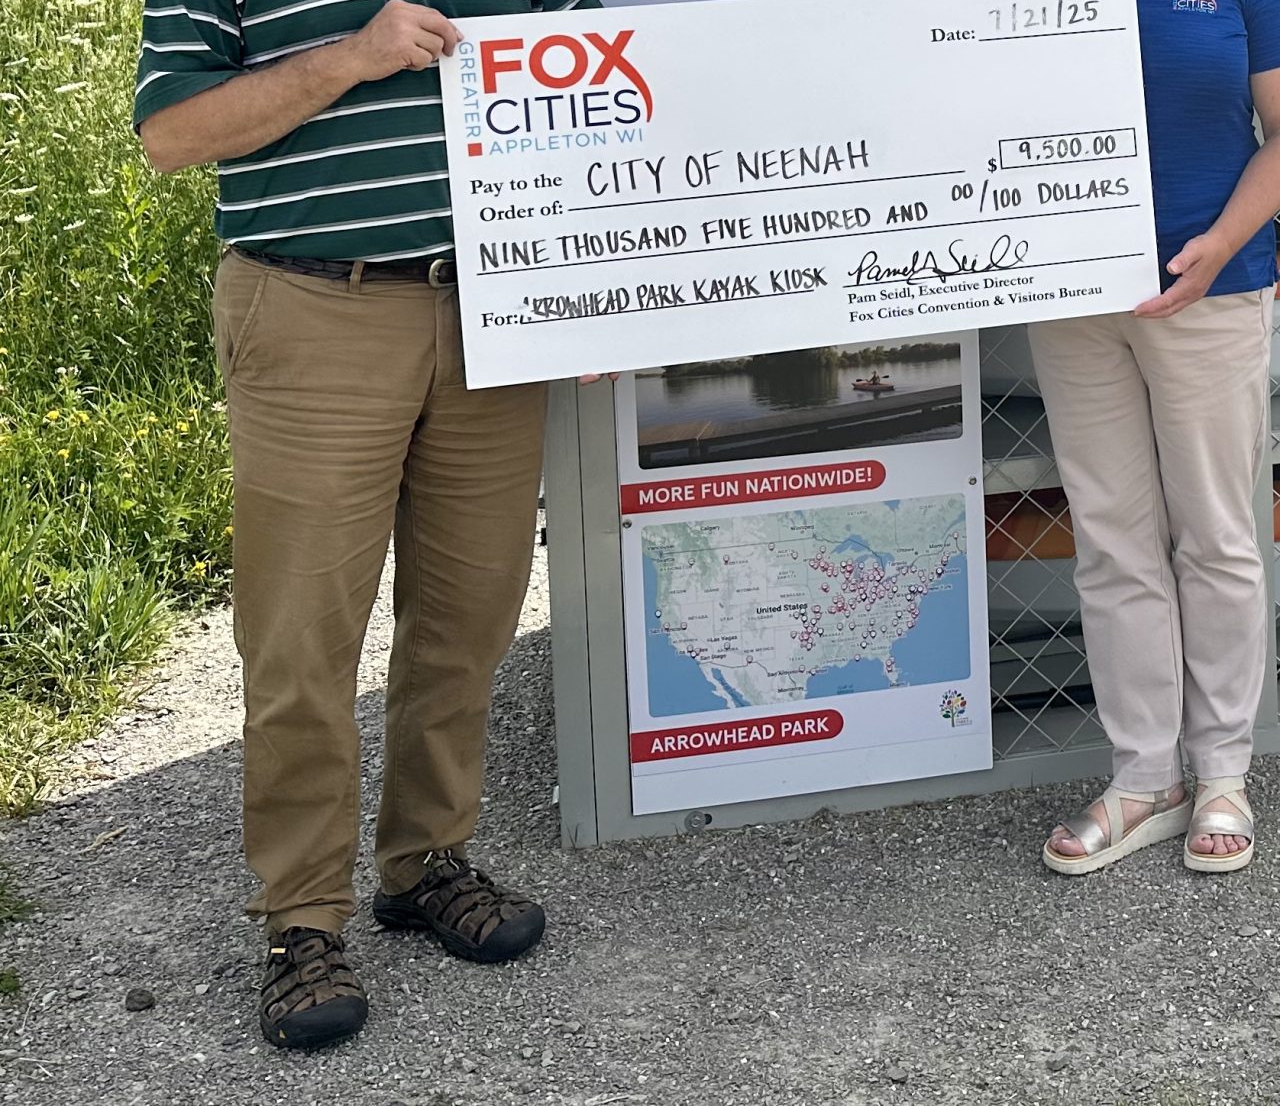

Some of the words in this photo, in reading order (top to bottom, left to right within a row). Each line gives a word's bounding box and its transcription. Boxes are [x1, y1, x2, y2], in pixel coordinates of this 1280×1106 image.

[1177, 0, 1215, 11] CITIES
[930, 28, 976, 42] Date:
[459, 41, 481, 138] GREATER
[480, 30, 653, 122] FOX
[486, 89, 641, 134] CITIES
[489, 131, 607, 155] APPLETON
[616, 128, 643, 143] WI
[1018, 134, 1116, 160] 9,500.00
[586, 156, 666, 197] CITY
[685, 150, 724, 188] OF
[737, 139, 870, 182] NEENAH
[987, 158, 998, 173] $
[470, 179, 504, 196] Pay
[510, 176, 528, 191] to
[534, 173, 563, 189] the
[479, 205, 535, 223] Order
[540, 201, 564, 217] of:
[479, 239, 550, 271] NINE
[557, 225, 687, 261] THOUSAND
[700, 215, 753, 245] FIVE
[762, 206, 871, 237] HUNDRED
[886, 202, 928, 225] AND
[1038, 177, 1130, 204] DOLLARS
[636, 282, 685, 310] PARK
[693, 275, 758, 303] KAYAK
[770, 266, 828, 294] KIOSK
[848, 292, 877, 304] Pam
[880, 288, 915, 300] Seidl,
[918, 280, 980, 296] Executive
[983, 274, 1034, 288] Director
[849, 309, 874, 322] Fox
[877, 305, 914, 318] Cities
[917, 297, 989, 314] Convention
[993, 295, 1005, 305] &
[1008, 290, 1055, 304] Visitors
[1058, 285, 1103, 299] Bureau
[481, 311, 519, 328] For:
[638, 485, 696, 505] MORE
[701, 480, 739, 499] FUN
[745, 467, 873, 495] NATIONWIDE!
[756, 604, 781, 614] United
[783, 602, 808, 612] States
[650, 722, 775, 754] ARROWHEAD
[781, 717, 830, 739] PARK
